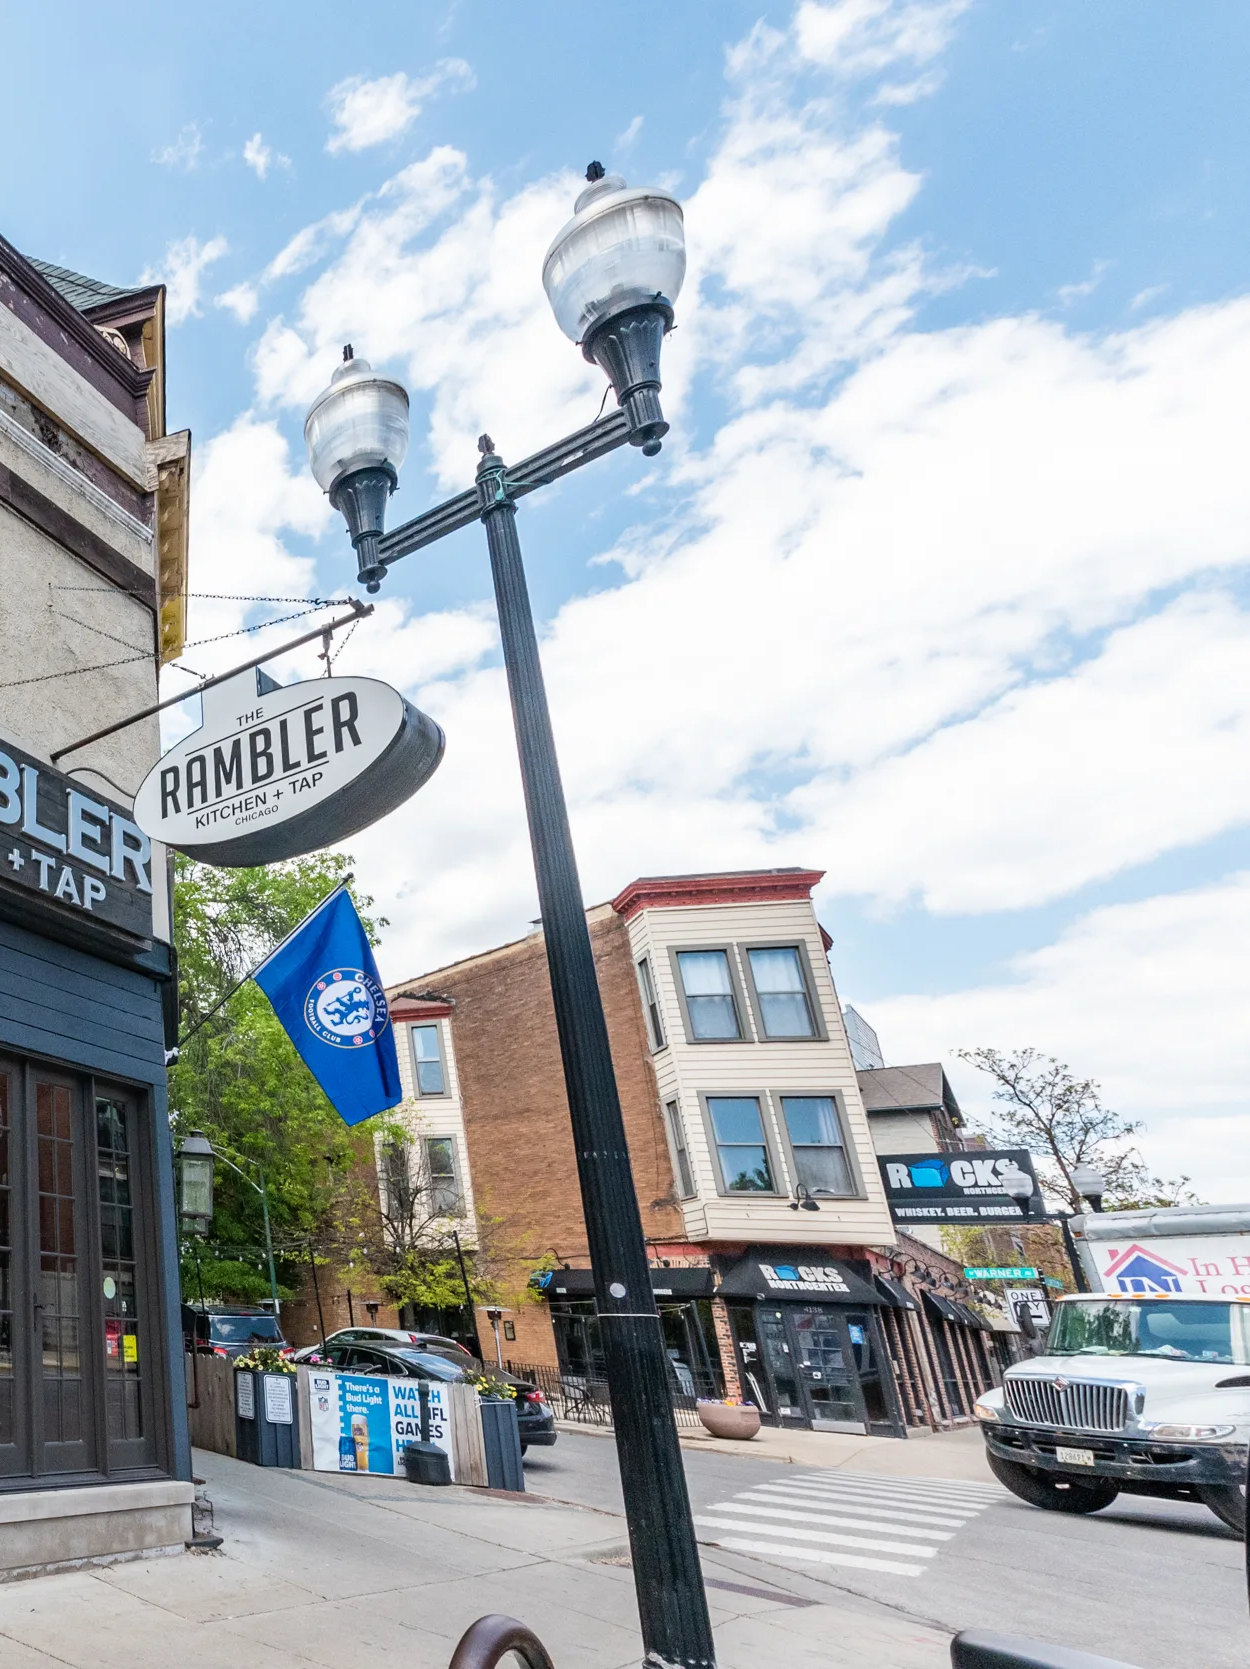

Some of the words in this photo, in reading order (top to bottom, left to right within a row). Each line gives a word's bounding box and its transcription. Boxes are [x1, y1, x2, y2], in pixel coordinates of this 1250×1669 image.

[236, 707, 264, 727] THE
[160, 691, 362, 819] RAMBLER
[195, 790, 267, 829] KITCHEN
[288, 772, 324, 795] TAP
[235, 804, 279, 826] CHICAGO
[355, 973, 386, 1022] CHELSEA
[308, 1000, 321, 1031] FOOTBALL
[322, 1031, 341, 1043] CLUB
[895, 1207, 945, 1217] WHISKEY.
[946, 1206, 978, 1216] BEER.
[973, 1269, 1023, 1279] WARNER
[1188, 1257, 1223, 1276] In
[767, 1279, 850, 1293] NORTHCENTER
[1011, 1291, 1038, 1301] ONE
[345, 1382, 374, 1393] There's
[393, 1386, 441, 1404] WAH
[346, 1393, 361, 1402] Bud
[363, 1394, 382, 1405] Light
[346, 1404, 369, 1414] there.
[394, 1404, 418, 1418] ALL
